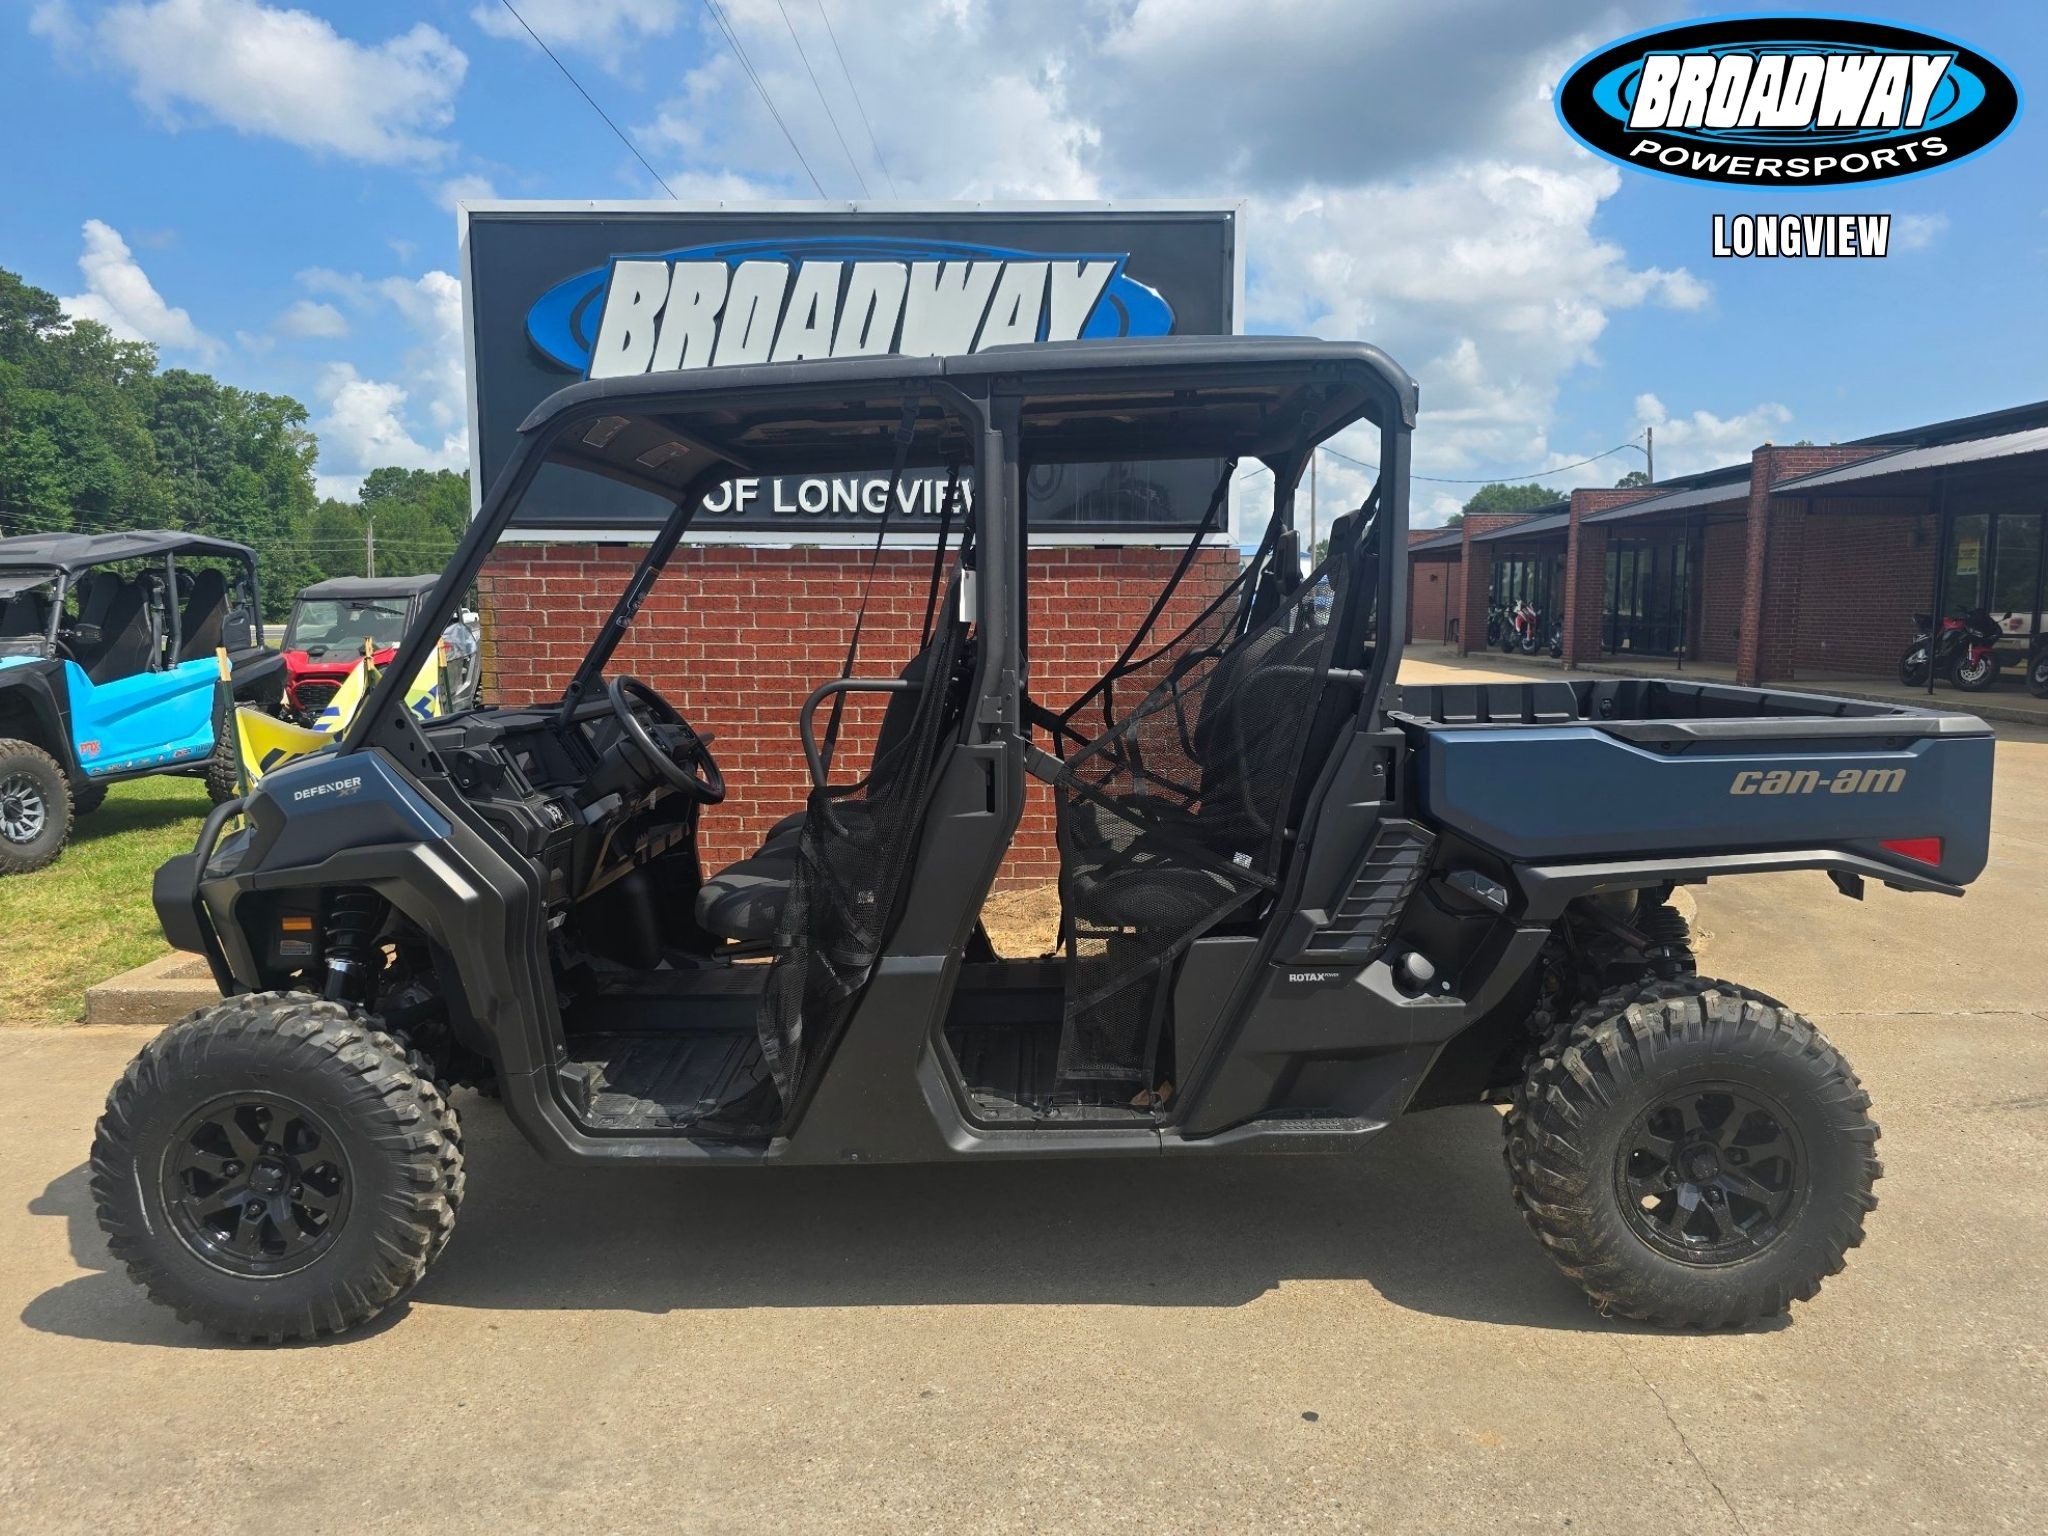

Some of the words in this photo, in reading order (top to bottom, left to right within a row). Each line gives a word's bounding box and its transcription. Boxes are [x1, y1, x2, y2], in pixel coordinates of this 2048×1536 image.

[588, 260, 1118, 379] BROADWAY
[702, 478, 760, 513] OF
[293, 776, 362, 801] DEFENDER
[1729, 768, 1907, 795] can-am
[1289, 973, 1325, 982] ROTAX
